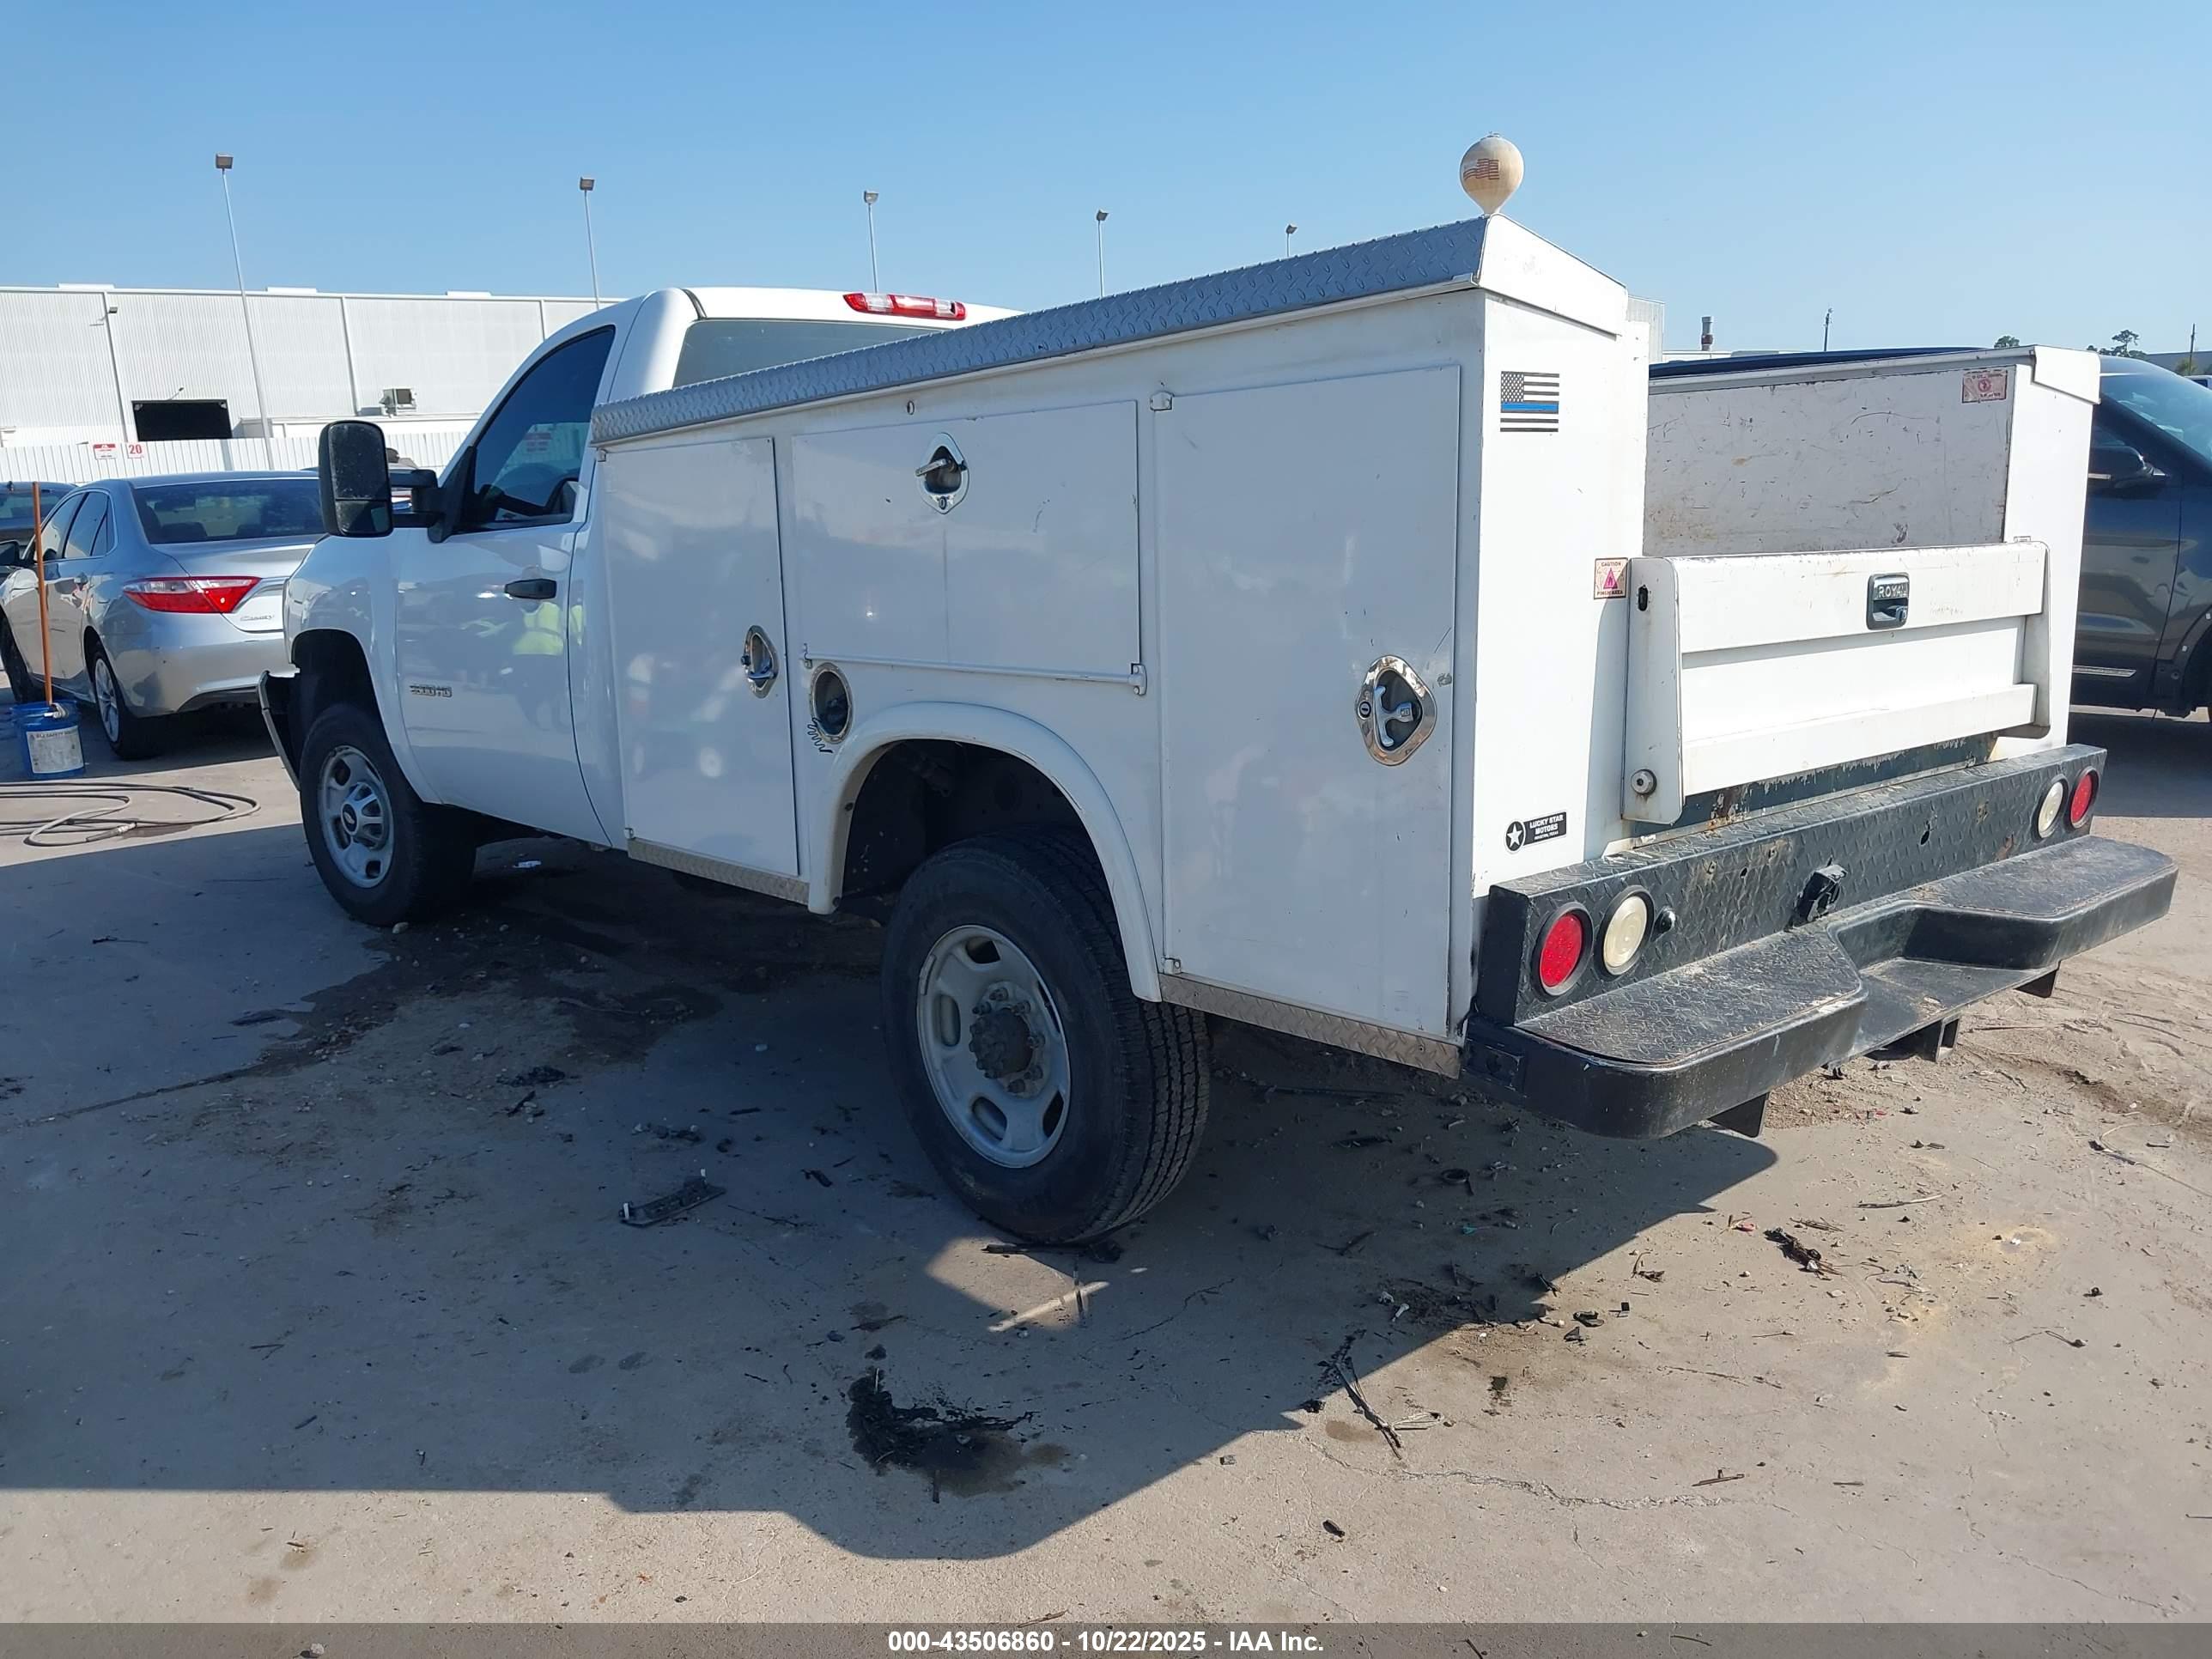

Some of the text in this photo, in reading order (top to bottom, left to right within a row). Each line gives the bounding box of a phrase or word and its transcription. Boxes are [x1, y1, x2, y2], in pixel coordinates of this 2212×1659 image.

[129, 444, 143, 454] 20
[1878, 585, 1908, 599] ROYAL
[1529, 814, 1564, 830] LUCKY STAR
[1534, 823, 1559, 835] MOTORS
